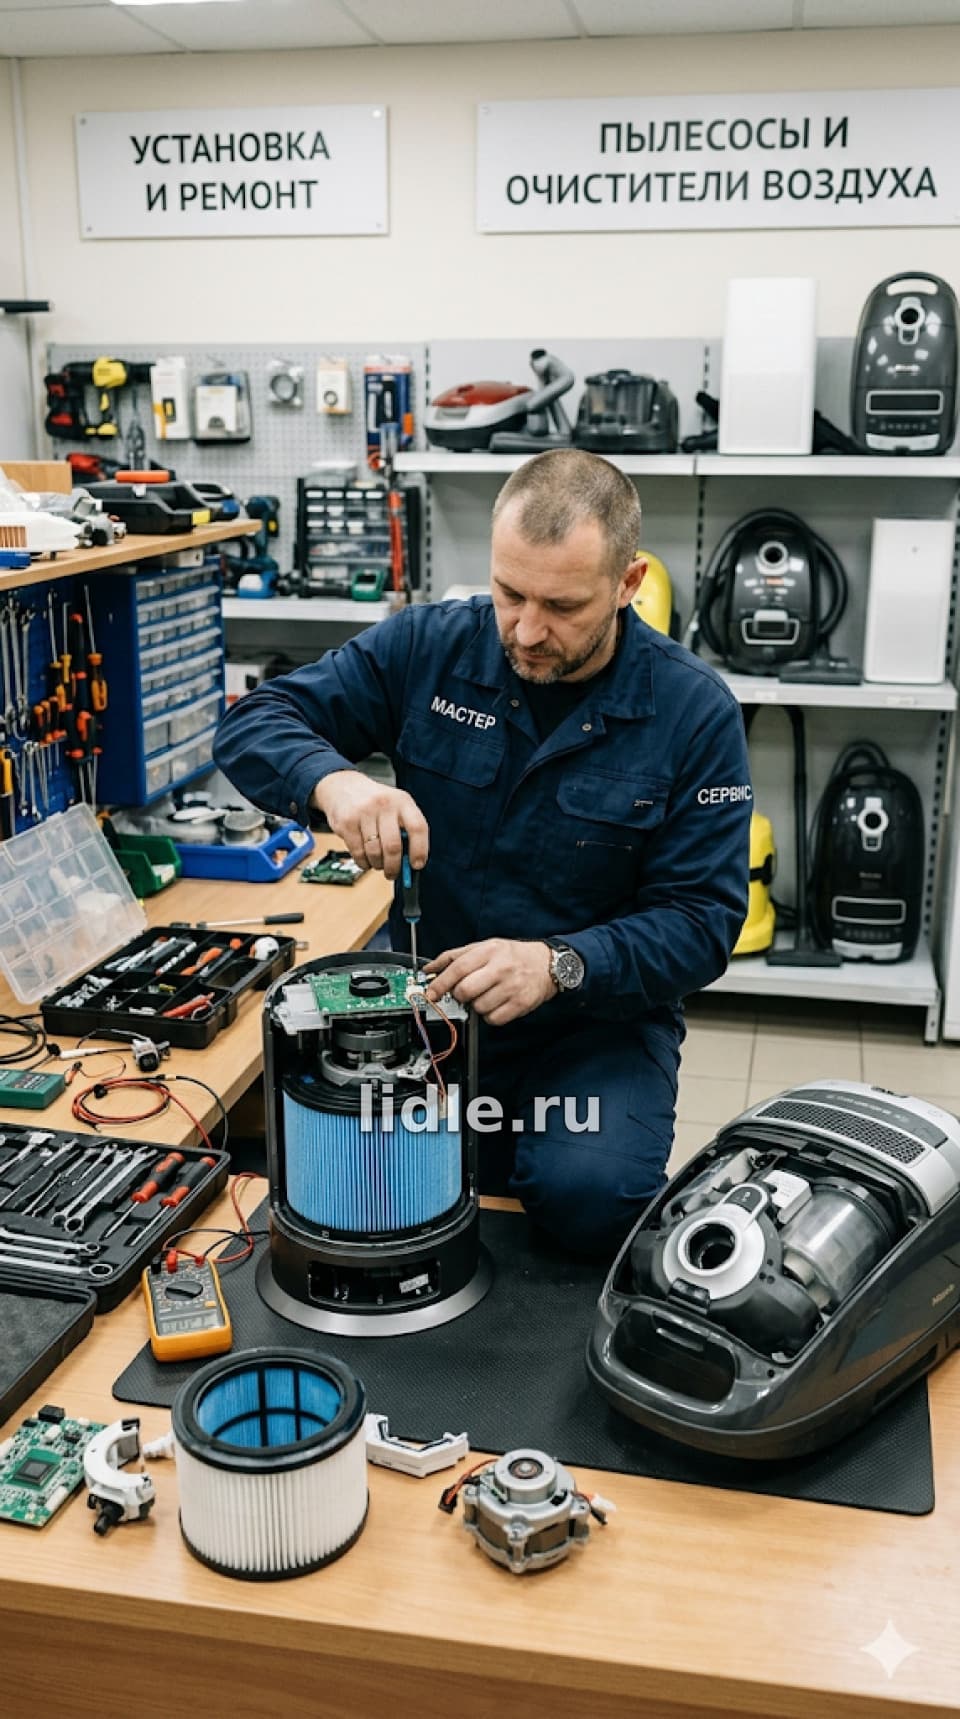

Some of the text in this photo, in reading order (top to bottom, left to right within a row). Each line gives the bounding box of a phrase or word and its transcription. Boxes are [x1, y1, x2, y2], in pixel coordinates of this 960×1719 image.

[129, 131, 330, 165] УСТАНОВКА
[600, 115, 849, 154] ПЫЛЕСОСЫ И
[145, 180, 319, 212] И РЕМОНТ
[506, 166, 938, 206] ОЧИСТИТЕЛИ ВОЗДУХА
[430, 696, 496, 730] МАСТЕР
